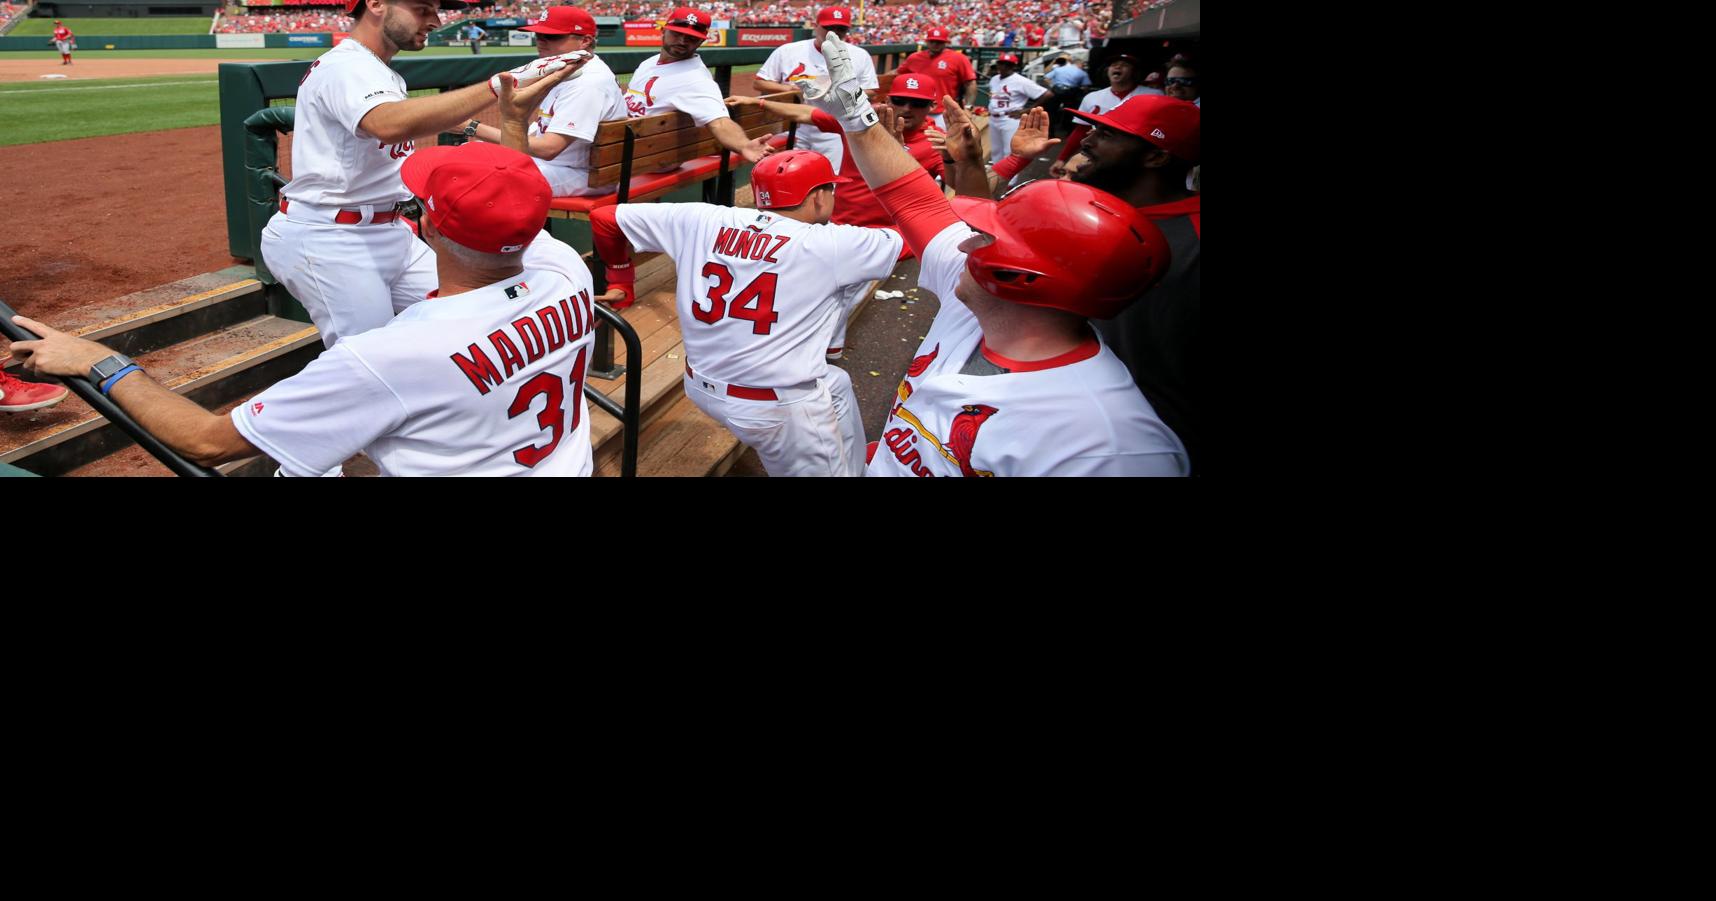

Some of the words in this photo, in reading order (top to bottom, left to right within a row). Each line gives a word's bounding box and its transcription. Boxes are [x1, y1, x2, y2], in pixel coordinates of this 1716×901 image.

[741, 34, 787, 42] EQUIFAX
[759, 191, 770, 200] 34
[712, 224, 791, 264] MUÑOZ
[692, 261, 778, 336] 34
[449, 288, 595, 396] MADDUX
[507, 345, 587, 469] 31
